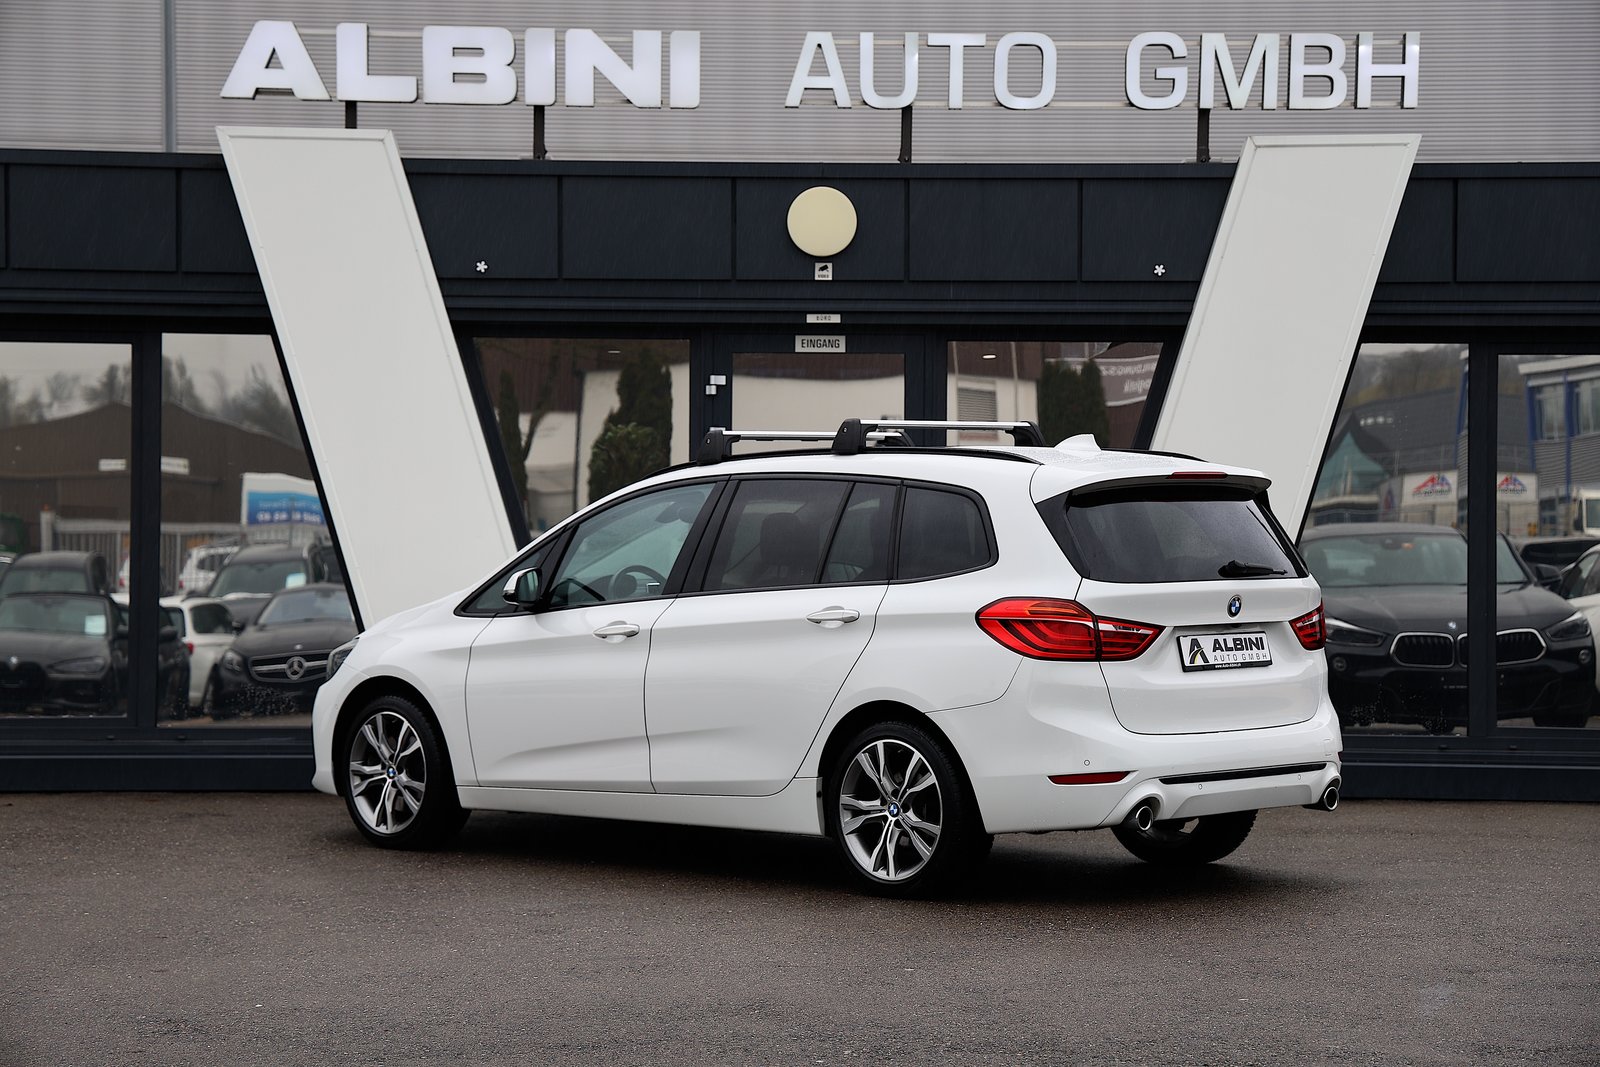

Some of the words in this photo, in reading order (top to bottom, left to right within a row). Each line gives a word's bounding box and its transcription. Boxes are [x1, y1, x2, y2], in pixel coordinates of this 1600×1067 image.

[220, 20, 700, 109] ALBINI
[785, 31, 1057, 110] AUTO
[1125, 31, 1421, 110] GMBH
[801, 338, 840, 349] EINGANG
[1212, 637, 1265, 653] ALBINI
[1213, 653, 1238, 662] AUTO
[1242, 652, 1268, 660] GMBH
